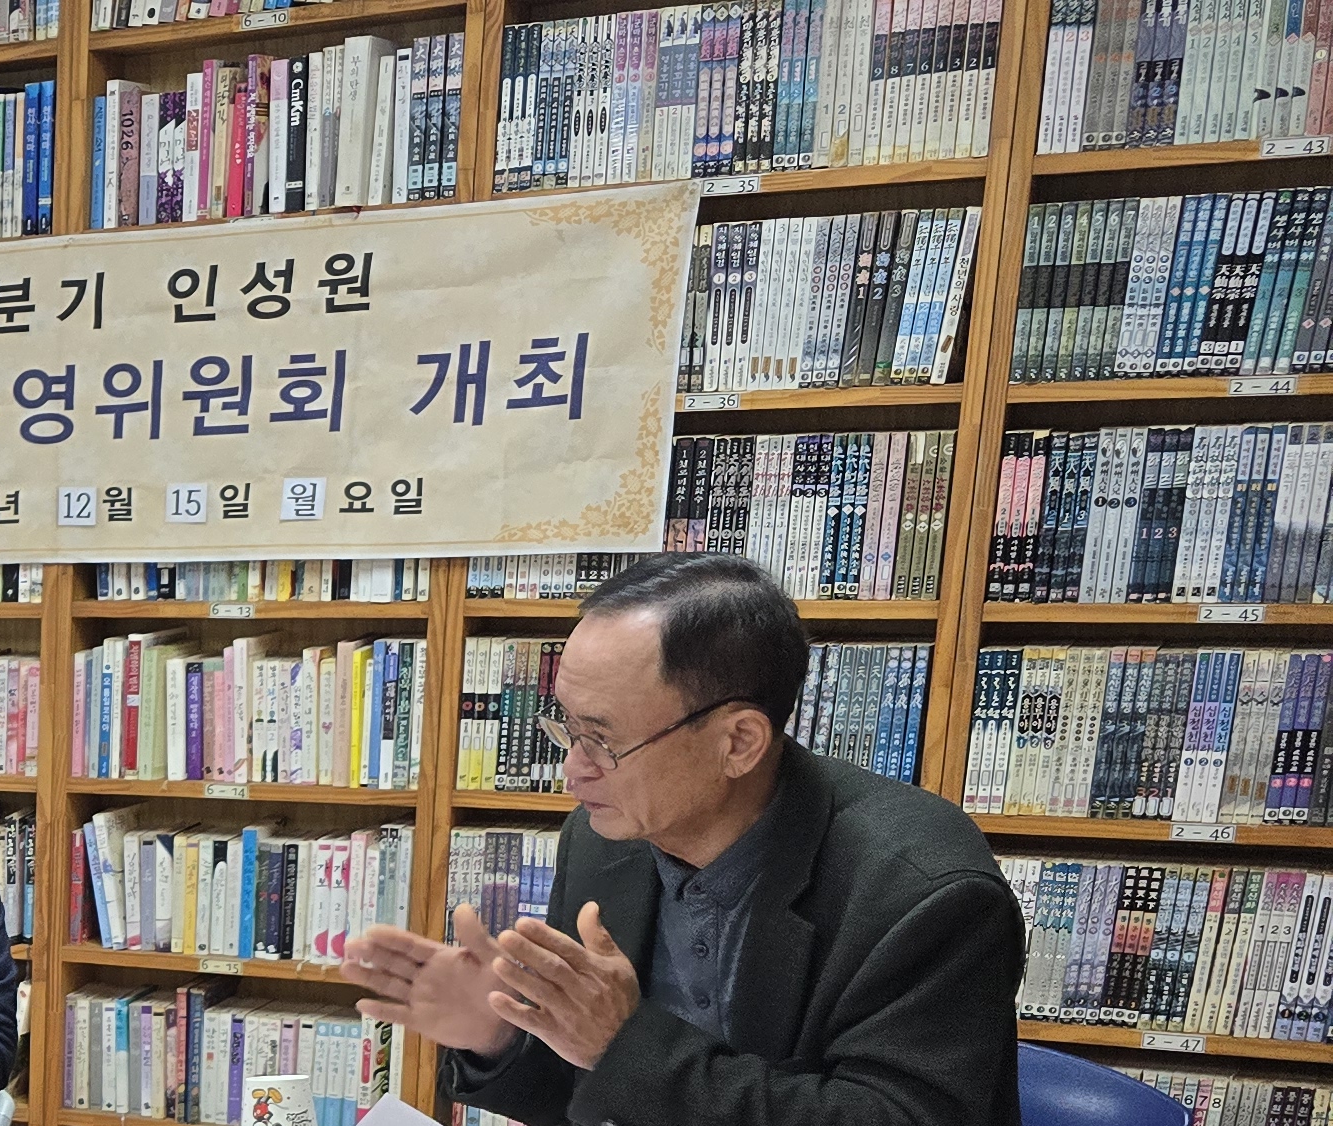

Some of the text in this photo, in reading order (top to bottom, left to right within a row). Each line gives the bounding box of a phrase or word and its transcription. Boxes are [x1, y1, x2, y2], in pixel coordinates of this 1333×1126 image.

[290, 79, 304, 126] CmKm
[120, 109, 134, 150] 1026
[1032, 217, 1039, 228] 1
[1048, 216, 1055, 227] 2
[1064, 215, 1073, 226] 3
[1080, 214, 1088, 225] 4
[1094, 212, 1102, 223] 5
[1110, 211, 1118, 223] 6
[1126, 211, 1135, 223] 7
[167, 251, 374, 323] 인성원
[408, 330, 592, 427] 개최
